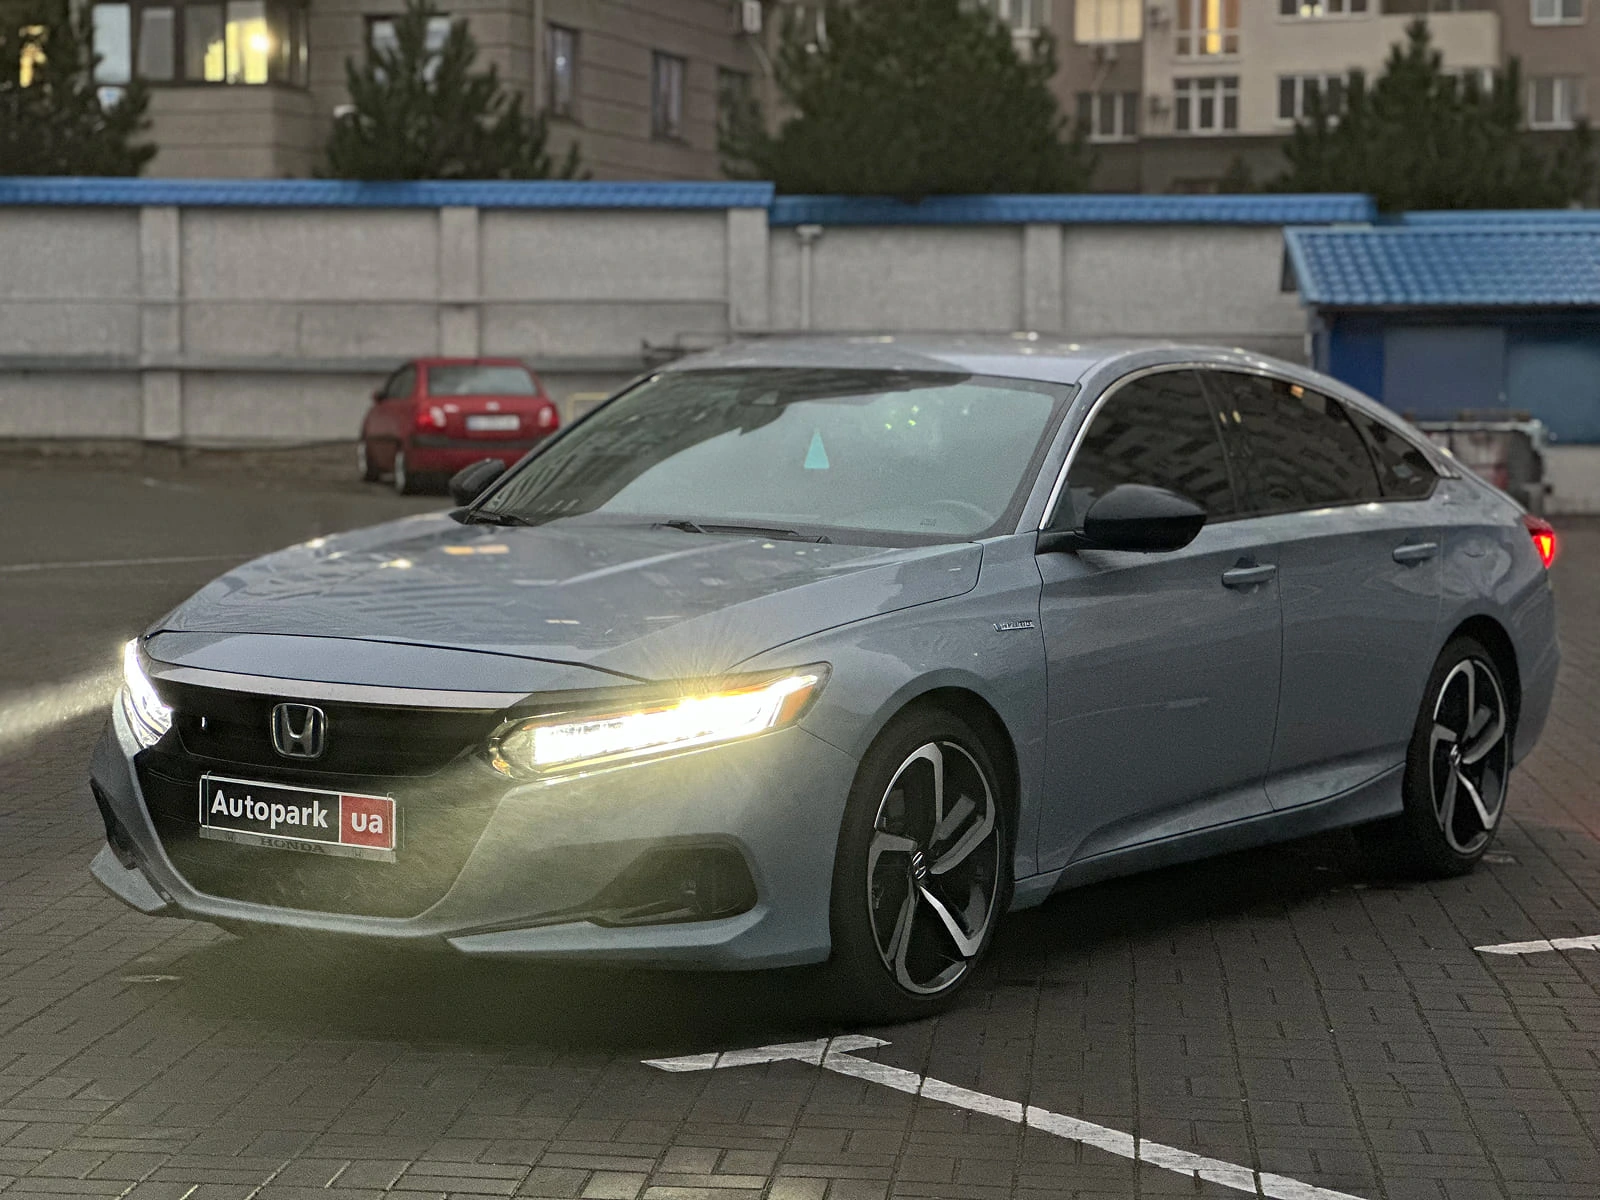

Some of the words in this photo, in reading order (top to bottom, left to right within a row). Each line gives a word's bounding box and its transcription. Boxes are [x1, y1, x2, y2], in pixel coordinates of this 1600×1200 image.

[210, 789, 329, 830] Autopark
[351, 812, 384, 834] ua
[260, 837, 326, 854] HONDA
